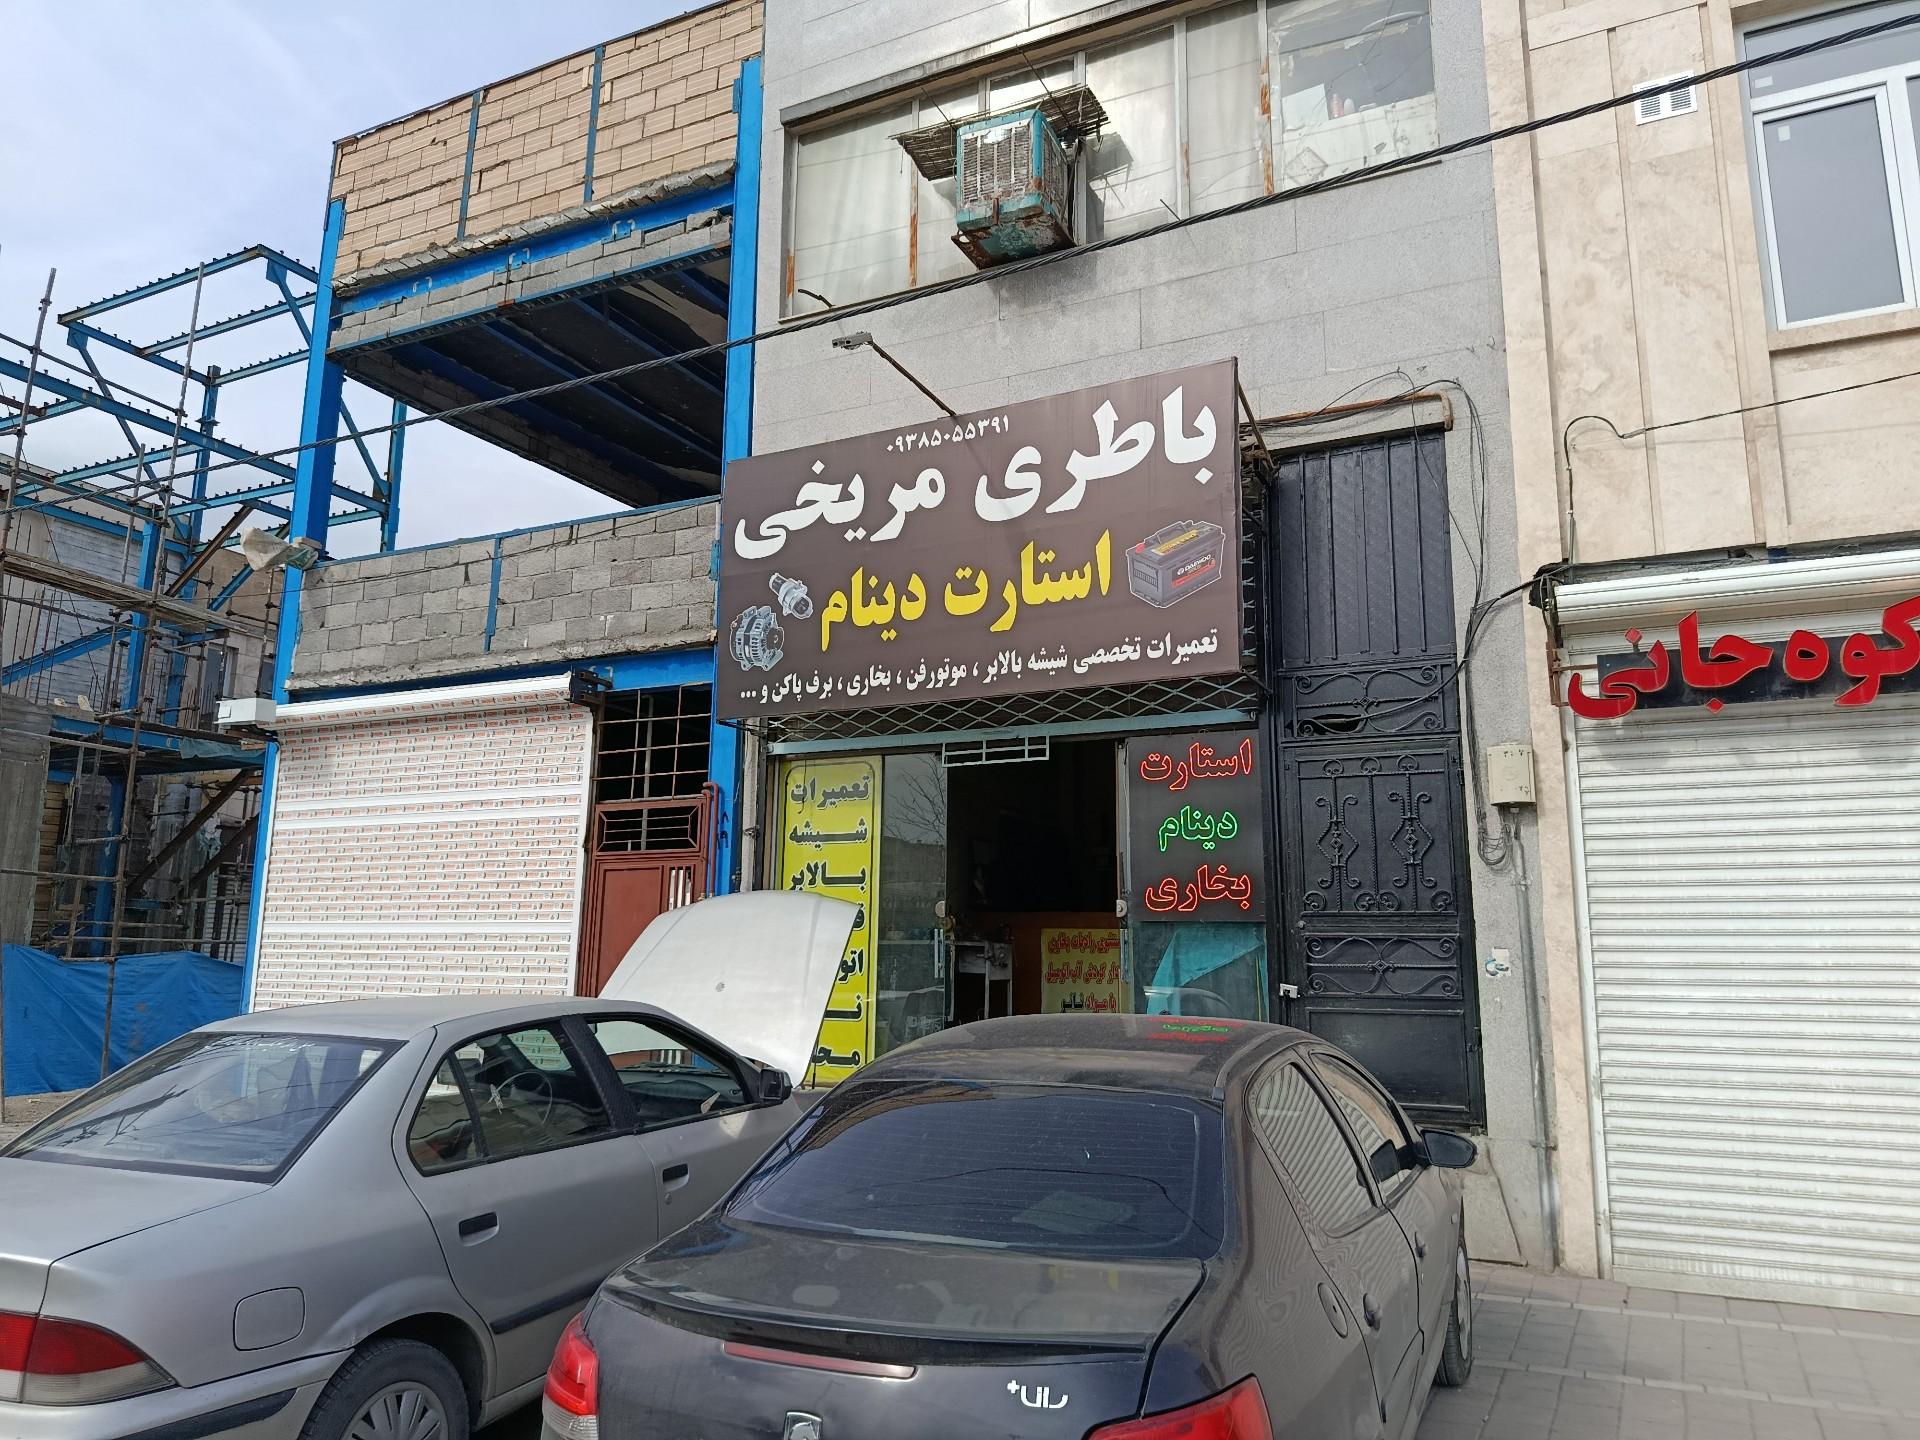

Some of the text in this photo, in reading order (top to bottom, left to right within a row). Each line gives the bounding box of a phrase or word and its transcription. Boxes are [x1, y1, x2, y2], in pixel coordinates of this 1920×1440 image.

[887, 414, 1009, 453] ۰۹۳۸۵۰۵۵۳۹۱
[733, 384, 1217, 560] باطری مریخی
[820, 528, 1111, 653] استارت دینام
[1027, 645, 1068, 676] شیشه
[1073, 636, 1141, 674] تخصصی
[1146, 628, 1218, 665] تعمیرات
[805, 670, 833, 700] برف
[846, 664, 891, 697] بخاری
[982, 650, 1022, 684] بالابر
[771, 672, 802, 703] پاکن
[1140, 738, 1252, 791] استارت
[790, 775, 870, 810] تعمیرات
[788, 818, 868, 850] شیشه
[1158, 805, 1238, 852] دینام
[788, 862, 867, 892] بالابر
[1145, 864, 1251, 912] بخاری
